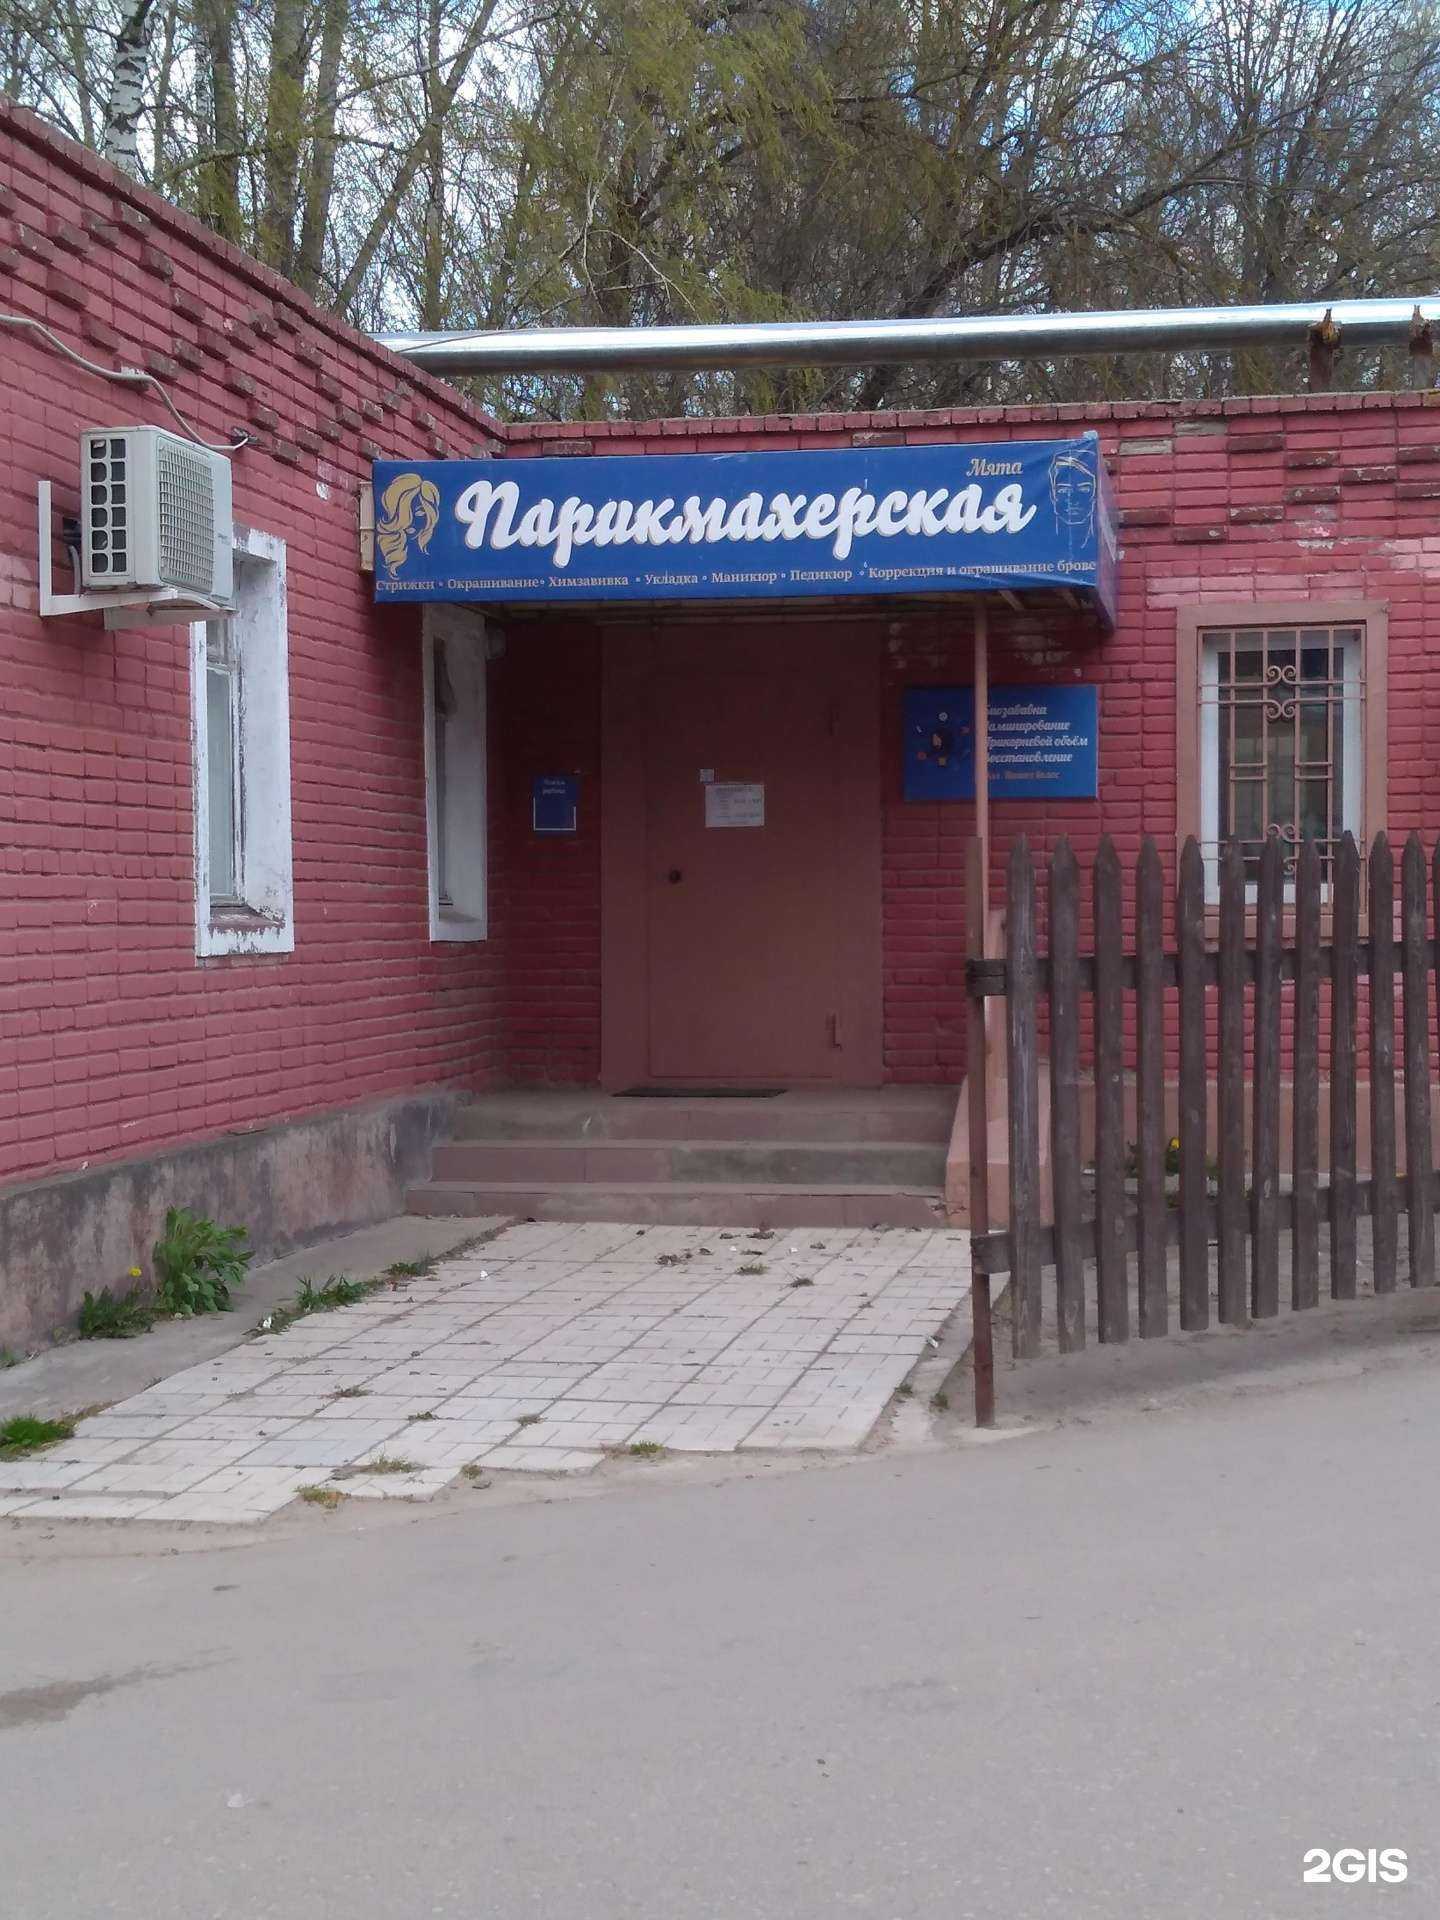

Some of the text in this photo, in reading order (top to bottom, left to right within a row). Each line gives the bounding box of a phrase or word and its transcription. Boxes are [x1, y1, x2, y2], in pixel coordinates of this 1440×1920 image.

[965, 458, 1023, 477] Мята
[455, 480, 1037, 568] Парикмахерская
[376, 579, 435, 593] Стрижки
[447, 577, 539, 592] Окрашивание
[548, 575, 629, 588] Химзавивка
[645, 573, 698, 586] Укладка
[711, 571, 777, 584] Маникюр
[790, 569, 852, 582] Педикюр
[869, 566, 943, 581] Коррекция
[947, 566, 957, 575] и
[959, 562, 1054, 577] окрашивание
[987, 720, 1071, 734] аминирование
[987, 751, 1073, 763] осстановление
